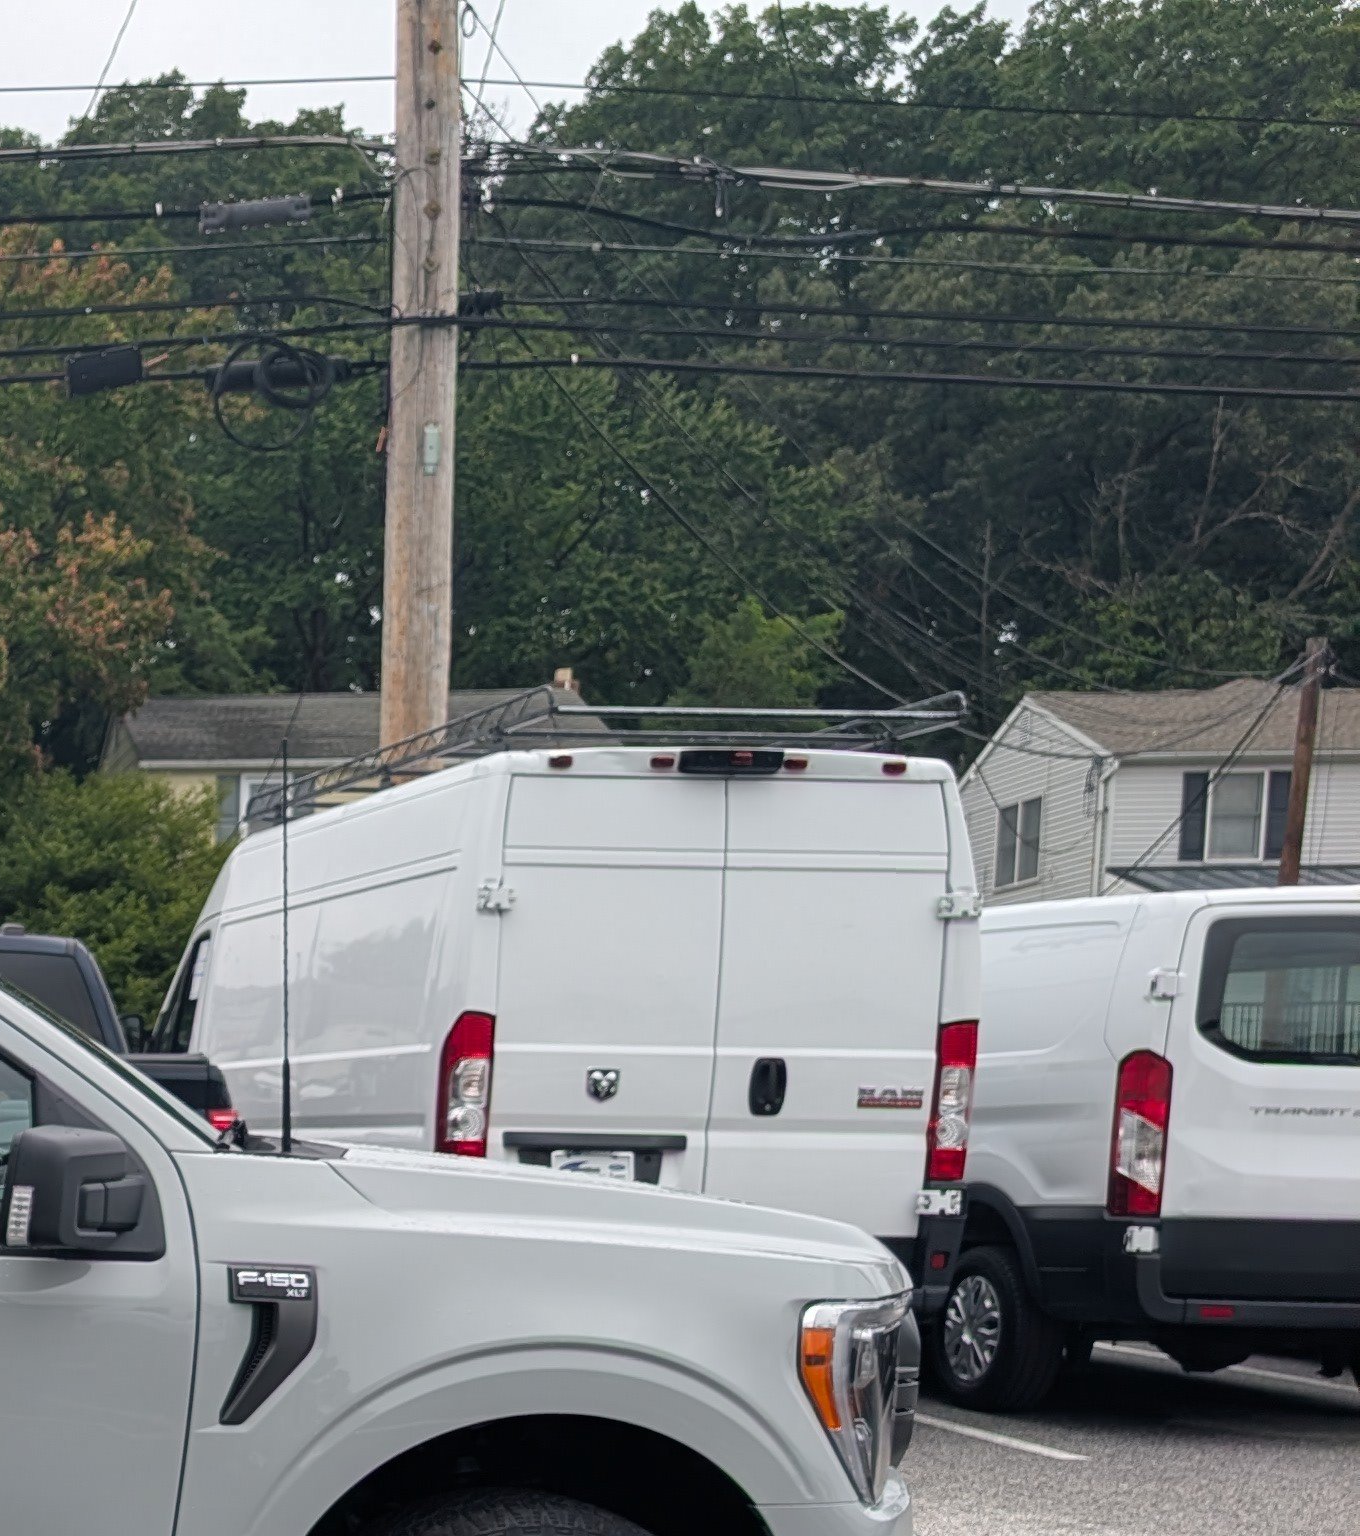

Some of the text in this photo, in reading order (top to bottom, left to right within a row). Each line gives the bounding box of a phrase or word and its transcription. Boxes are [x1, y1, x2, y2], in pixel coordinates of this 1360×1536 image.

[1248, 1106, 1351, 1116] TRANSIT
[237, 1271, 309, 1288] F-150
[286, 1288, 309, 1298] XLT
